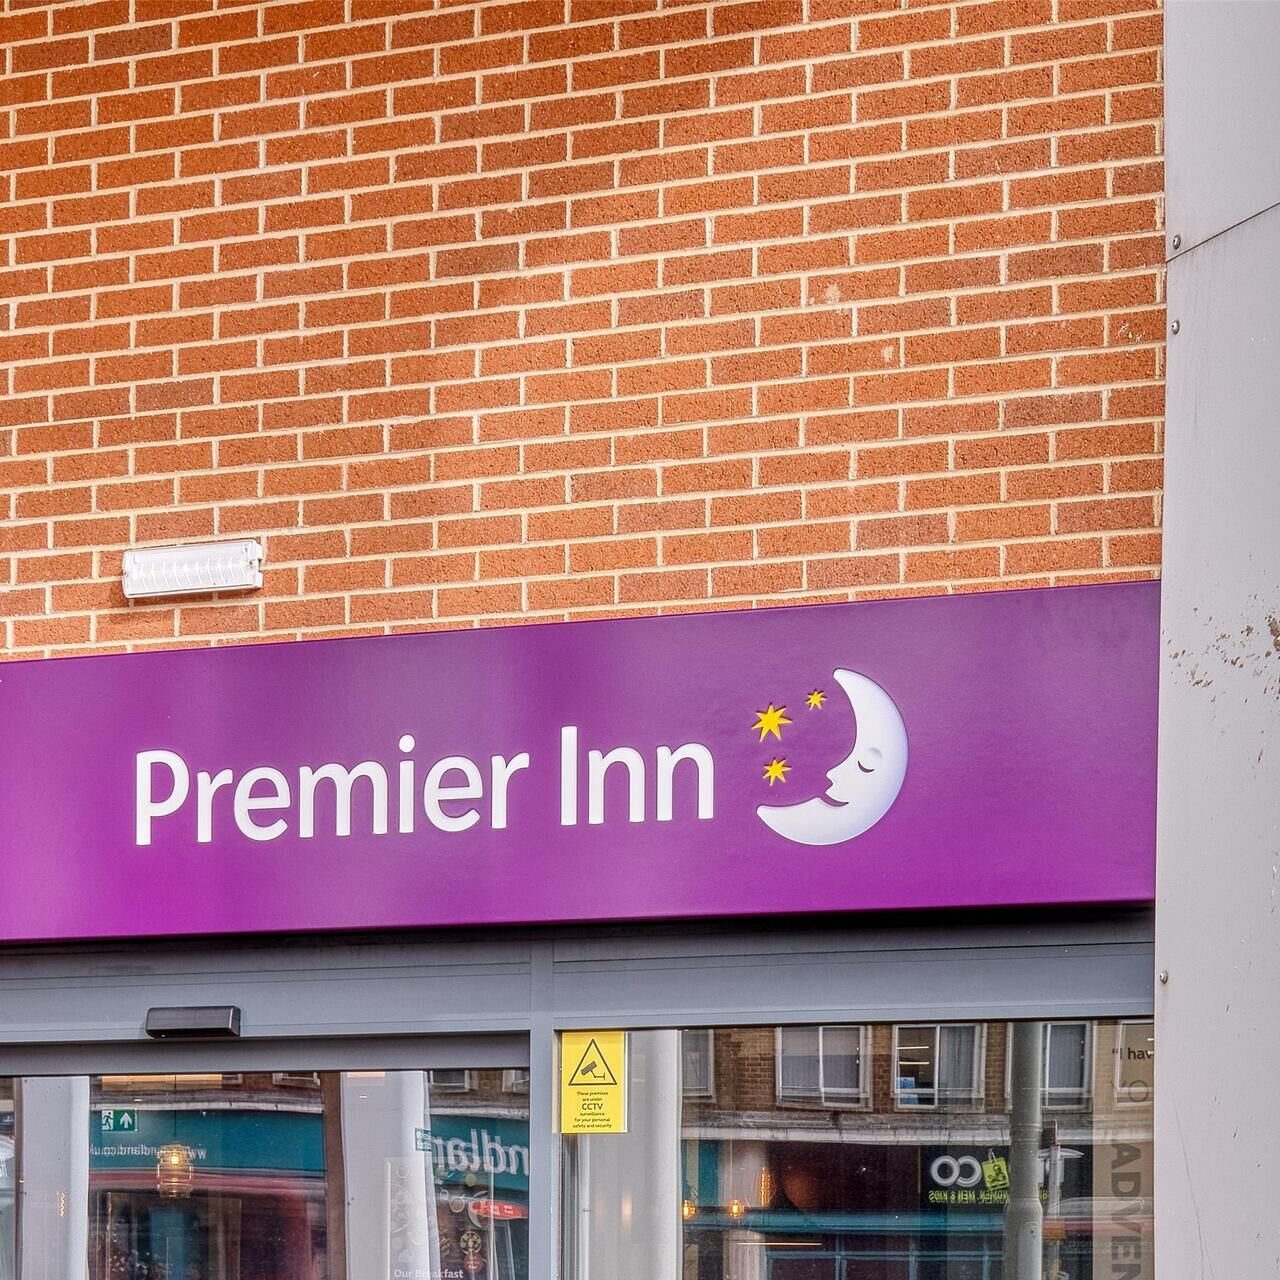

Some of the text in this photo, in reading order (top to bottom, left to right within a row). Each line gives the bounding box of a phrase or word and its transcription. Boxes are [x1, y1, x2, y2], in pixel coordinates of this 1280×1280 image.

[136, 725, 715, 847] Premier Inn
[581, 1103, 604, 1111] CCTV
[393, 1268, 464, 1279] Our Brakfast
